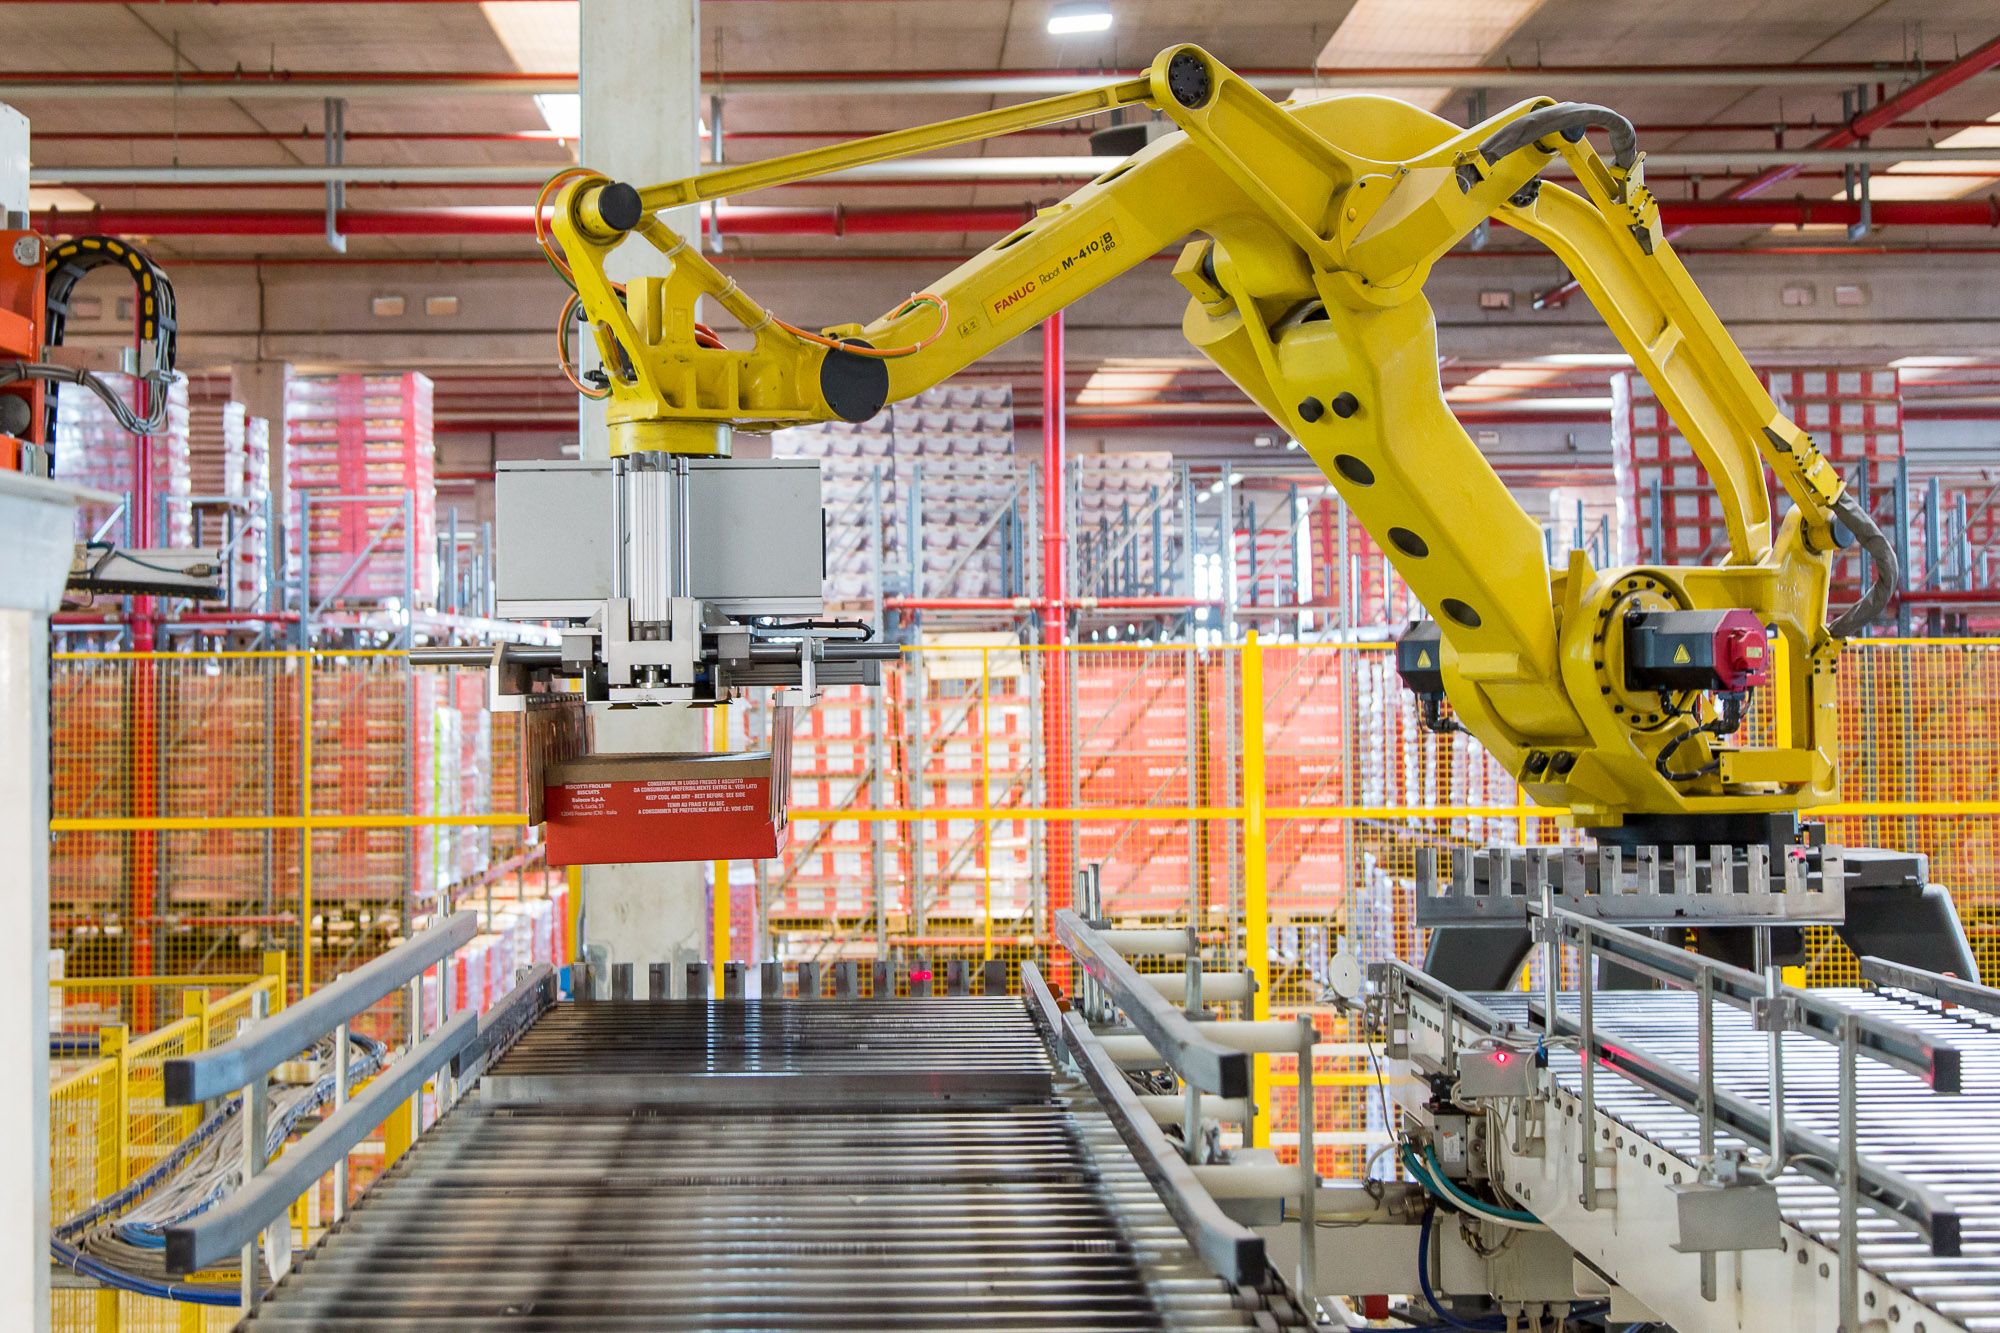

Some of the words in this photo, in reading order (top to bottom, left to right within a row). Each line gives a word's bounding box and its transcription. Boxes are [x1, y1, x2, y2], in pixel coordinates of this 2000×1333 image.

[1102, 242, 1116, 253] 160
[994, 282, 1036, 314] FANUC
[1038, 267, 1060, 285] Robot
